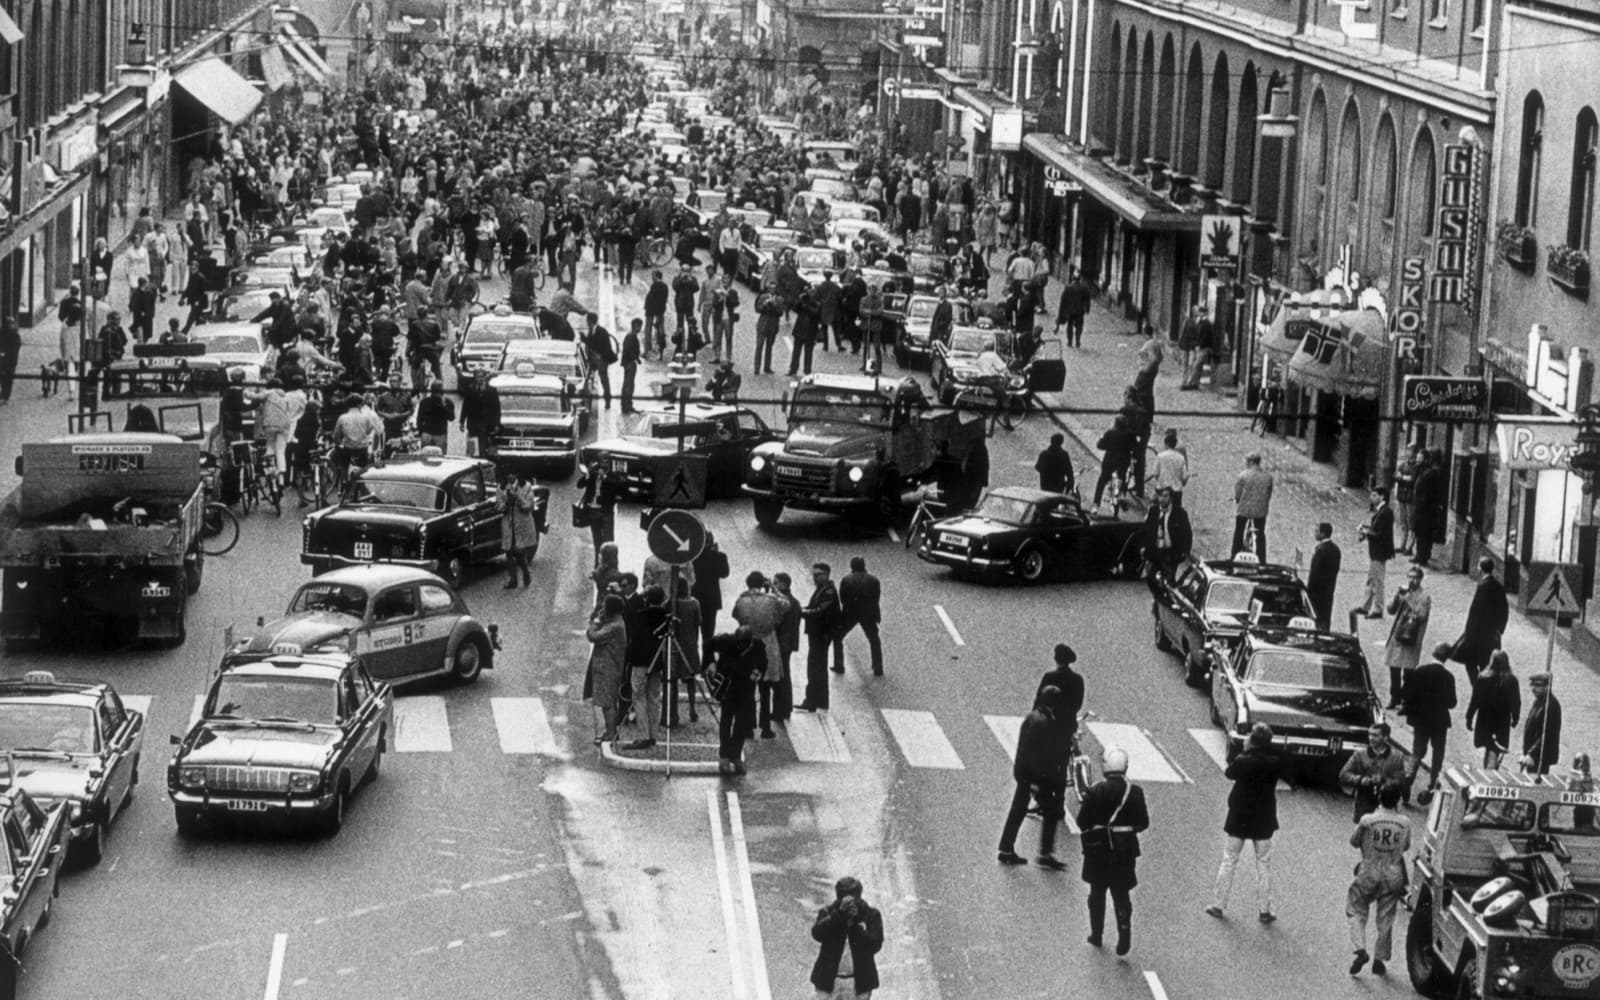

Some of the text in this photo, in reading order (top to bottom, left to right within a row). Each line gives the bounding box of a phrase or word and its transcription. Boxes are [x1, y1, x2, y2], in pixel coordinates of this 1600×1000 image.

[1398, 259, 1422, 358] SKOR
[404, 624, 413, 645] 9
[1562, 954, 1596, 973] BRC
